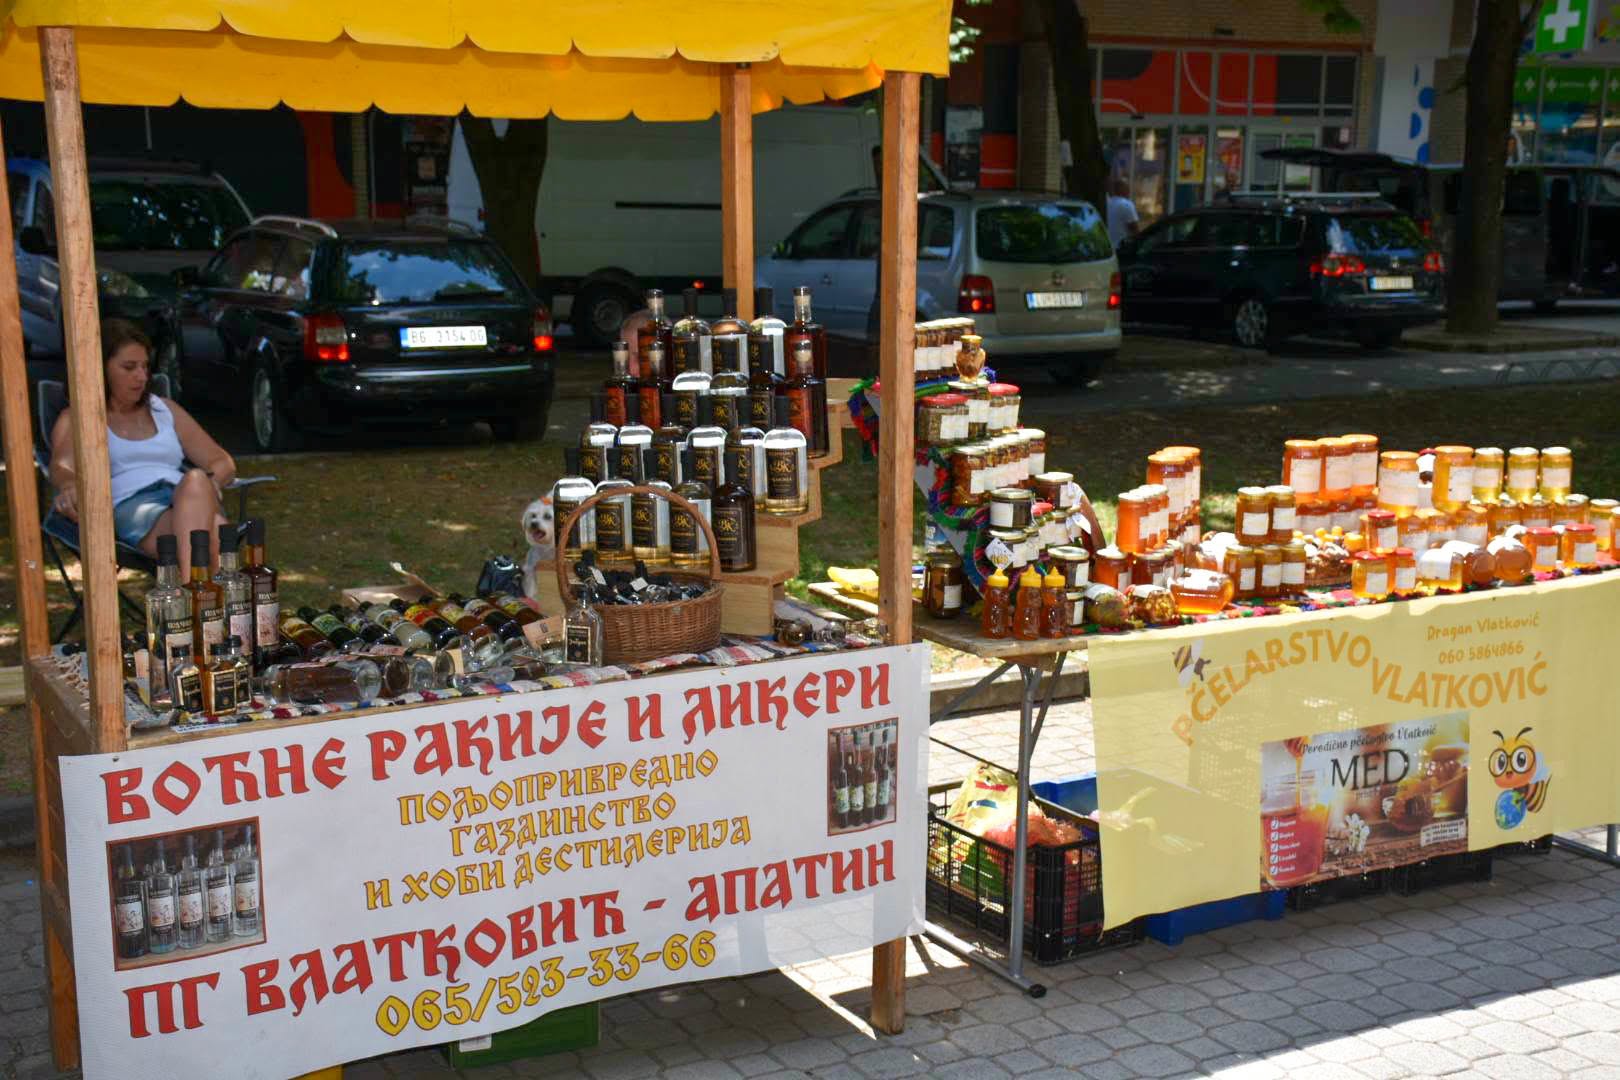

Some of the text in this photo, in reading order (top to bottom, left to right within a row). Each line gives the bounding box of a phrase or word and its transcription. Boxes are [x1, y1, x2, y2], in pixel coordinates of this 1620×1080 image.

[1426, 608, 1540, 642] Dragan Vlatković
[1438, 648, 1466, 665] 060
[1171, 628, 1549, 747] PČELARSTVO VLATKOVIĆ
[100, 662, 891, 824] ВОЋНЕ РАКИЈЕ И ЛИКЕРИ
[1330, 749, 1410, 791] MED
[397, 748, 719, 825] ПОЉОПРИВРЕДНО
[449, 791, 677, 856] ГАЗДИНСТВО
[364, 815, 752, 910] И ХОБИ ДЕСТИЛЕРИЈА
[123, 972, 221, 1038] ПГ
[240, 890, 626, 1017] ВЛАТКОВИЋ
[684, 839, 896, 924] АПАТИН
[375, 930, 716, 1036] 065/523-33-66
